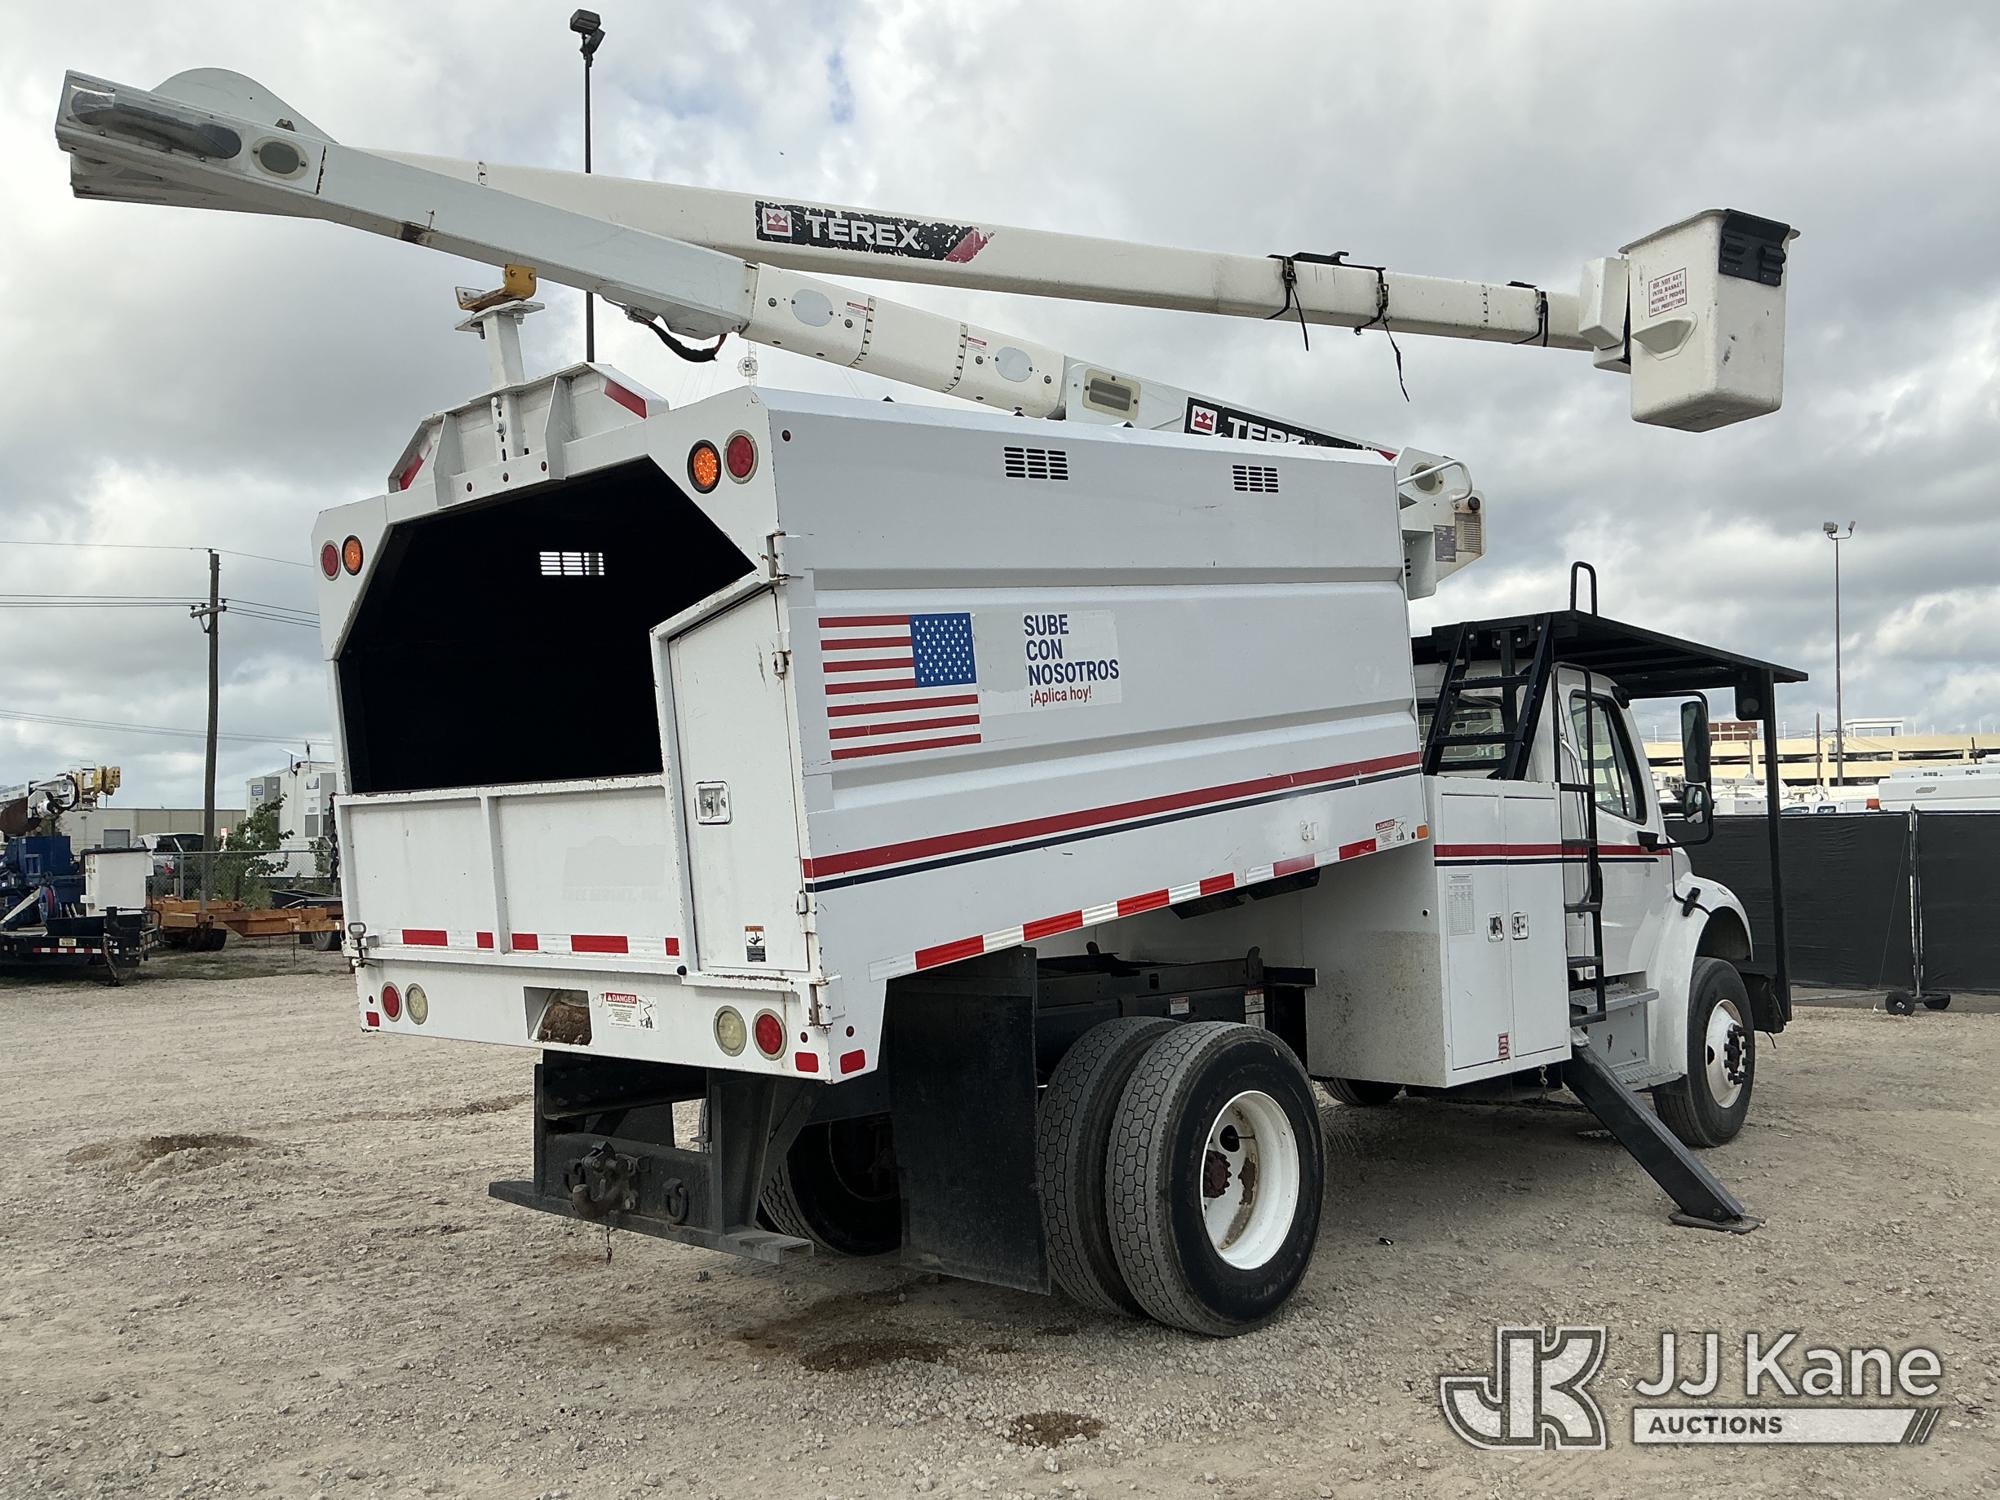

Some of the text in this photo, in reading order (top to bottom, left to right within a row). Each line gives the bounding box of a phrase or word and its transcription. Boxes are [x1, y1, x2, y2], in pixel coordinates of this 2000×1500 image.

[804, 214, 921, 250] TEREX
[1228, 416, 1306, 444] TER
[1024, 614, 1069, 636] SUBE
[1026, 639, 1063, 661] CON
[1028, 659, 1119, 686] NOSOTROS
[1030, 685, 1092, 707] ¡Aplica hoy!
[612, 995, 636, 1004] DANGER
